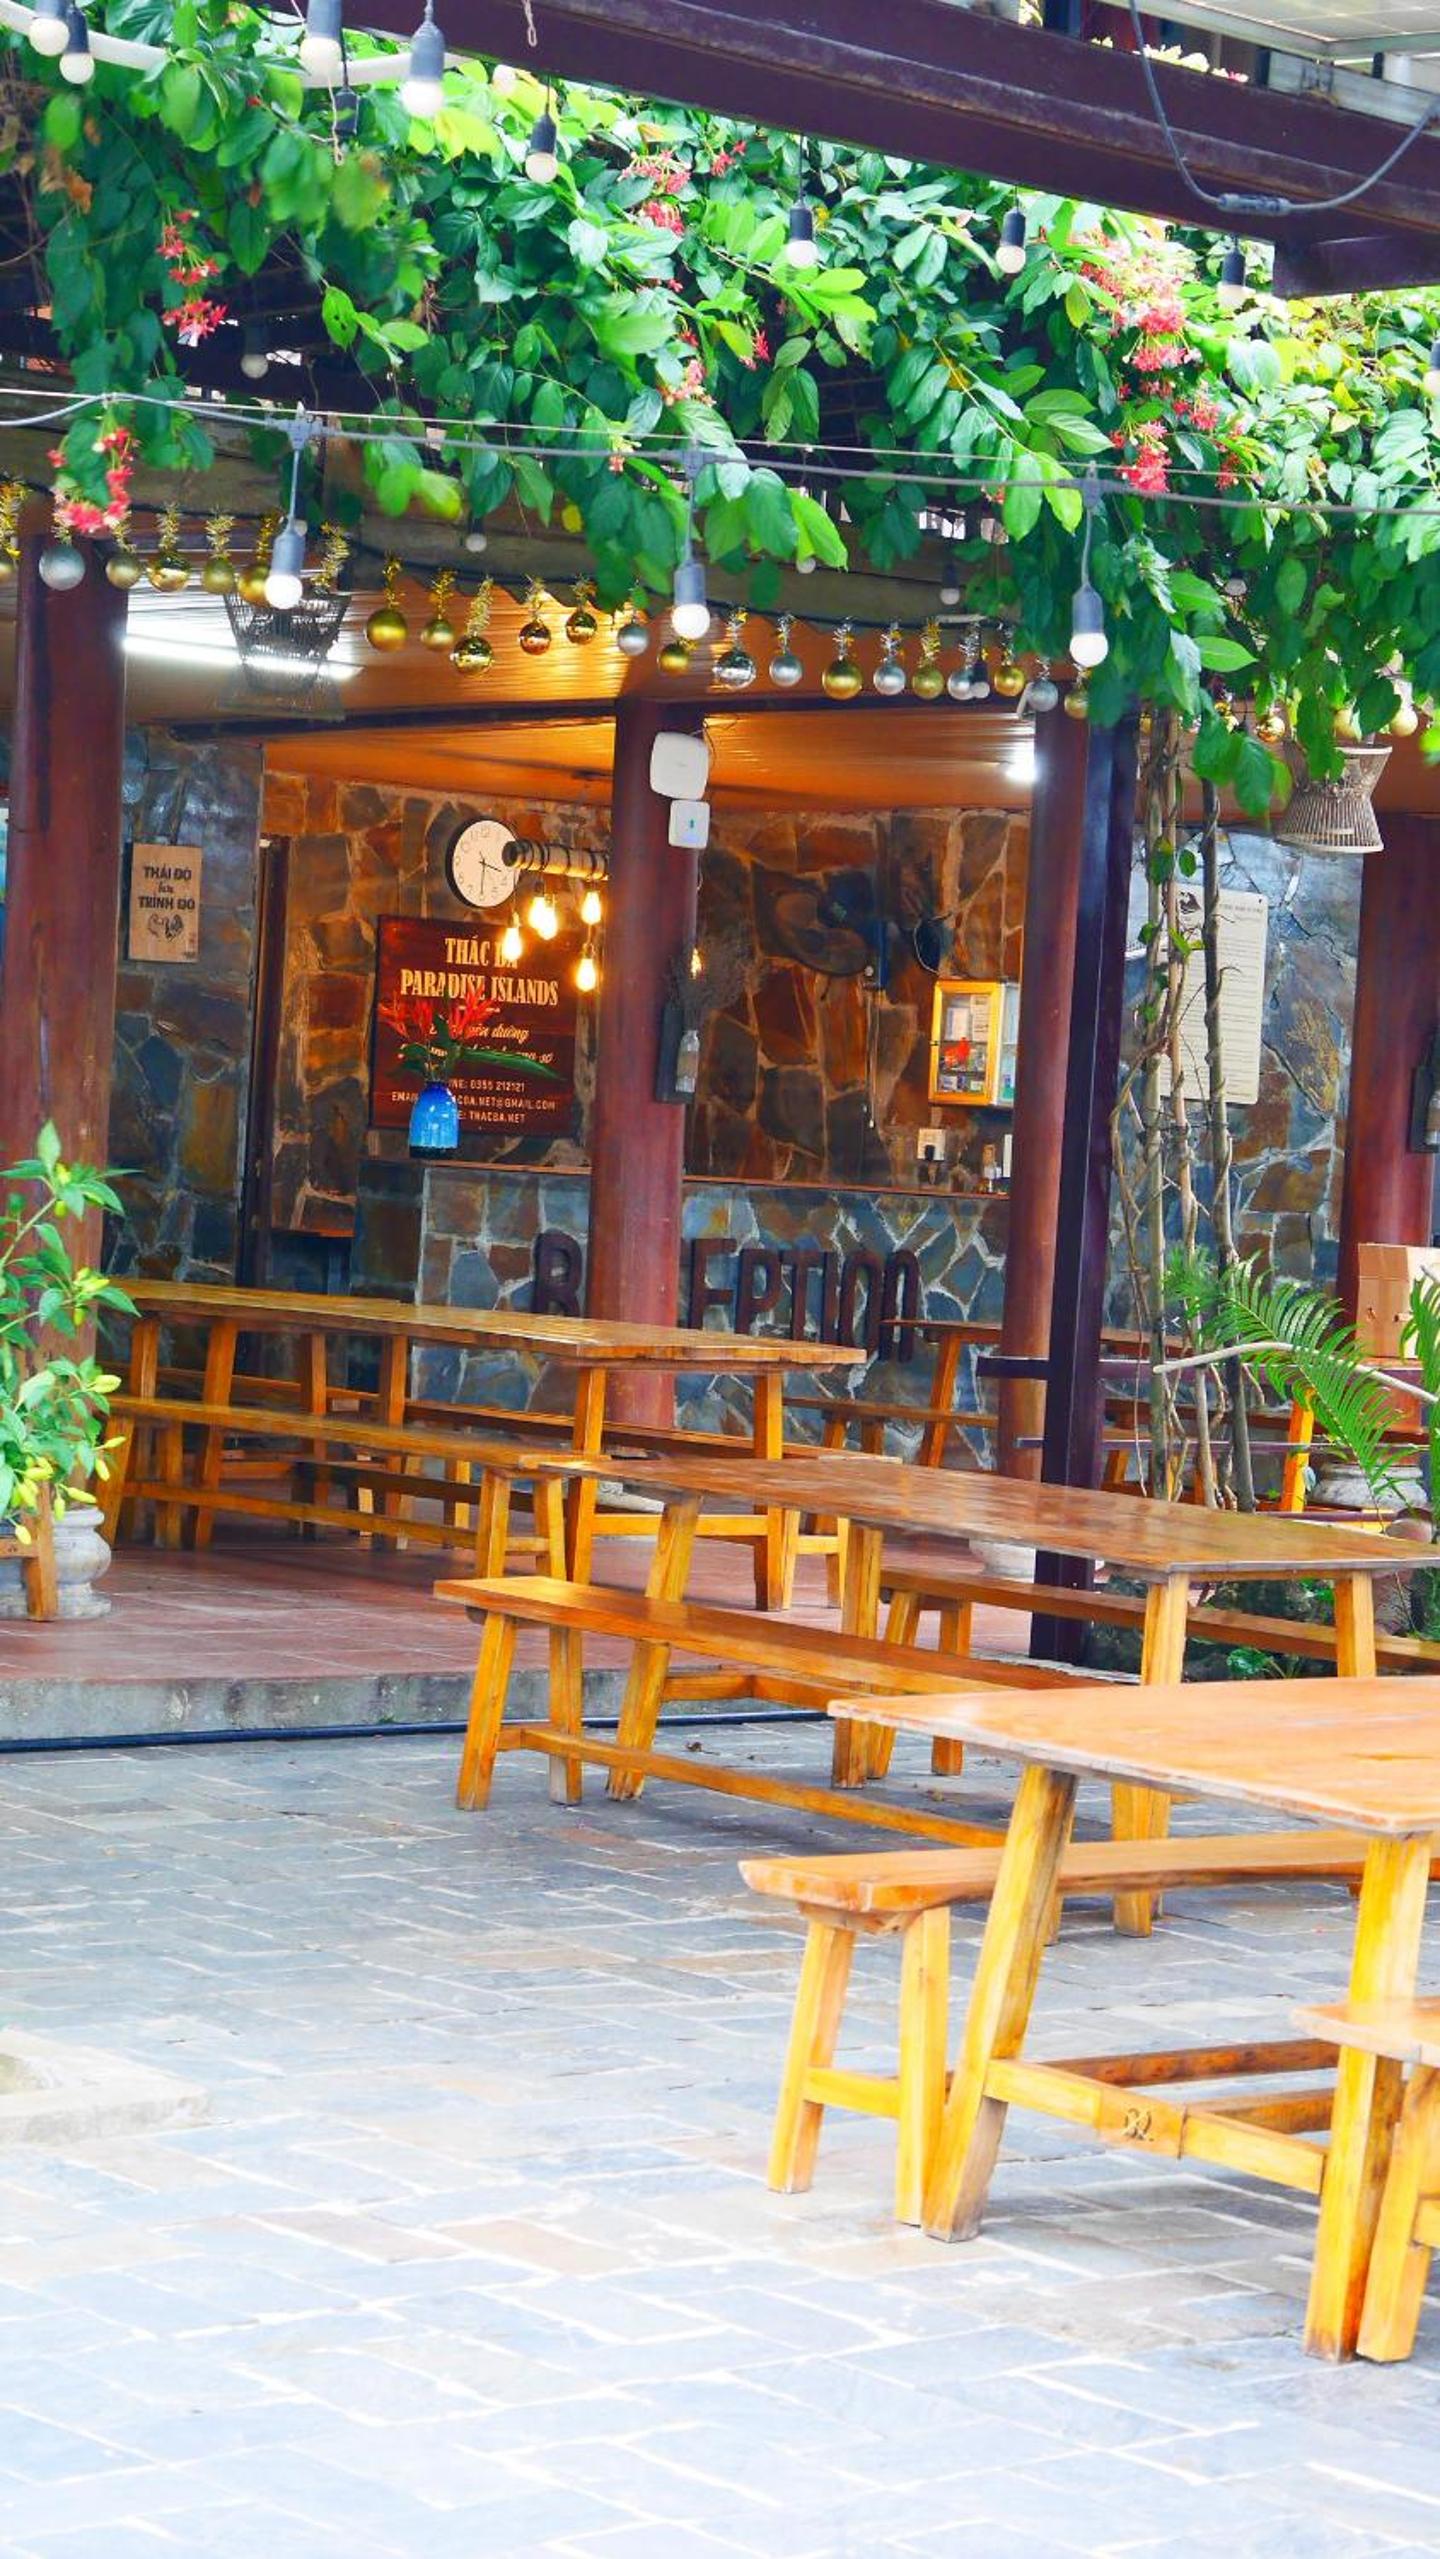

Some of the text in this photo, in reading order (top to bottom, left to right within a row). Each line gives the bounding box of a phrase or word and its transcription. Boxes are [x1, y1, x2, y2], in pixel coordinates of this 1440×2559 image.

[445, 935, 491, 967] THÁC
[400, 968, 559, 1007] PARADISE ISLANDS
[531, 1227, 922, 1363] REPTION
